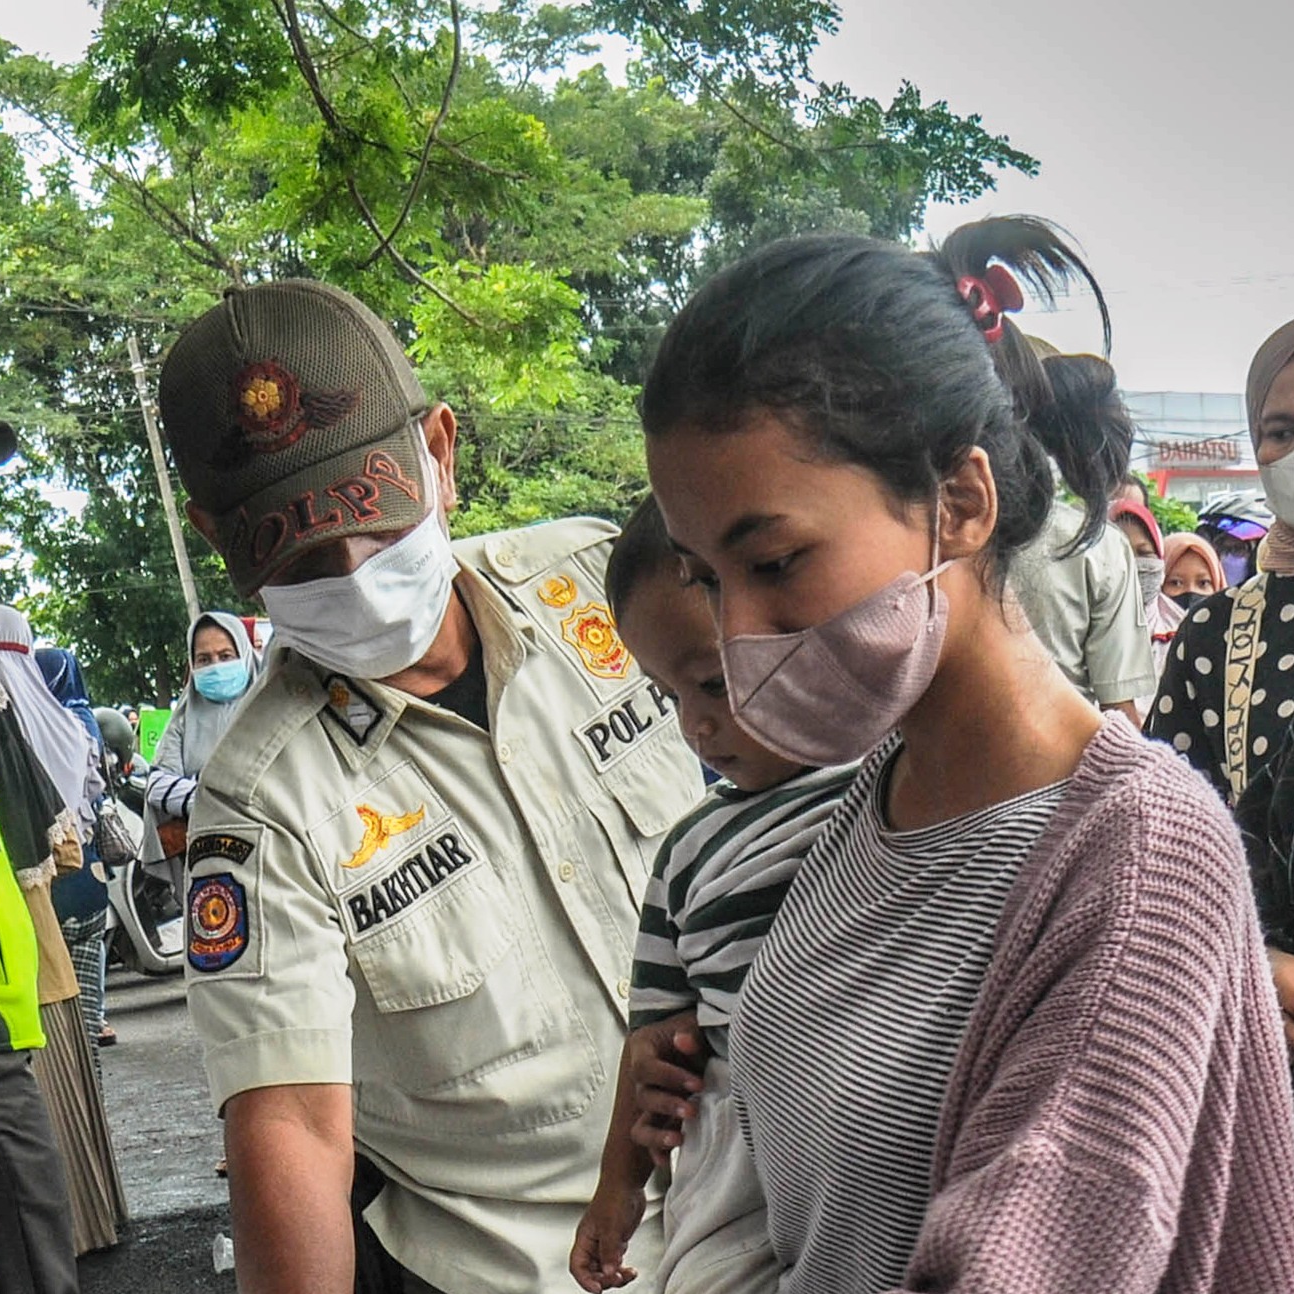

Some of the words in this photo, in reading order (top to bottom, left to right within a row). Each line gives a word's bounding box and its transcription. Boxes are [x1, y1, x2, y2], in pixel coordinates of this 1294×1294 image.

[1160, 441, 1237, 461] DAIHATSU
[584, 700, 652, 762] POL
[348, 833, 472, 933] BAKHTIAR
